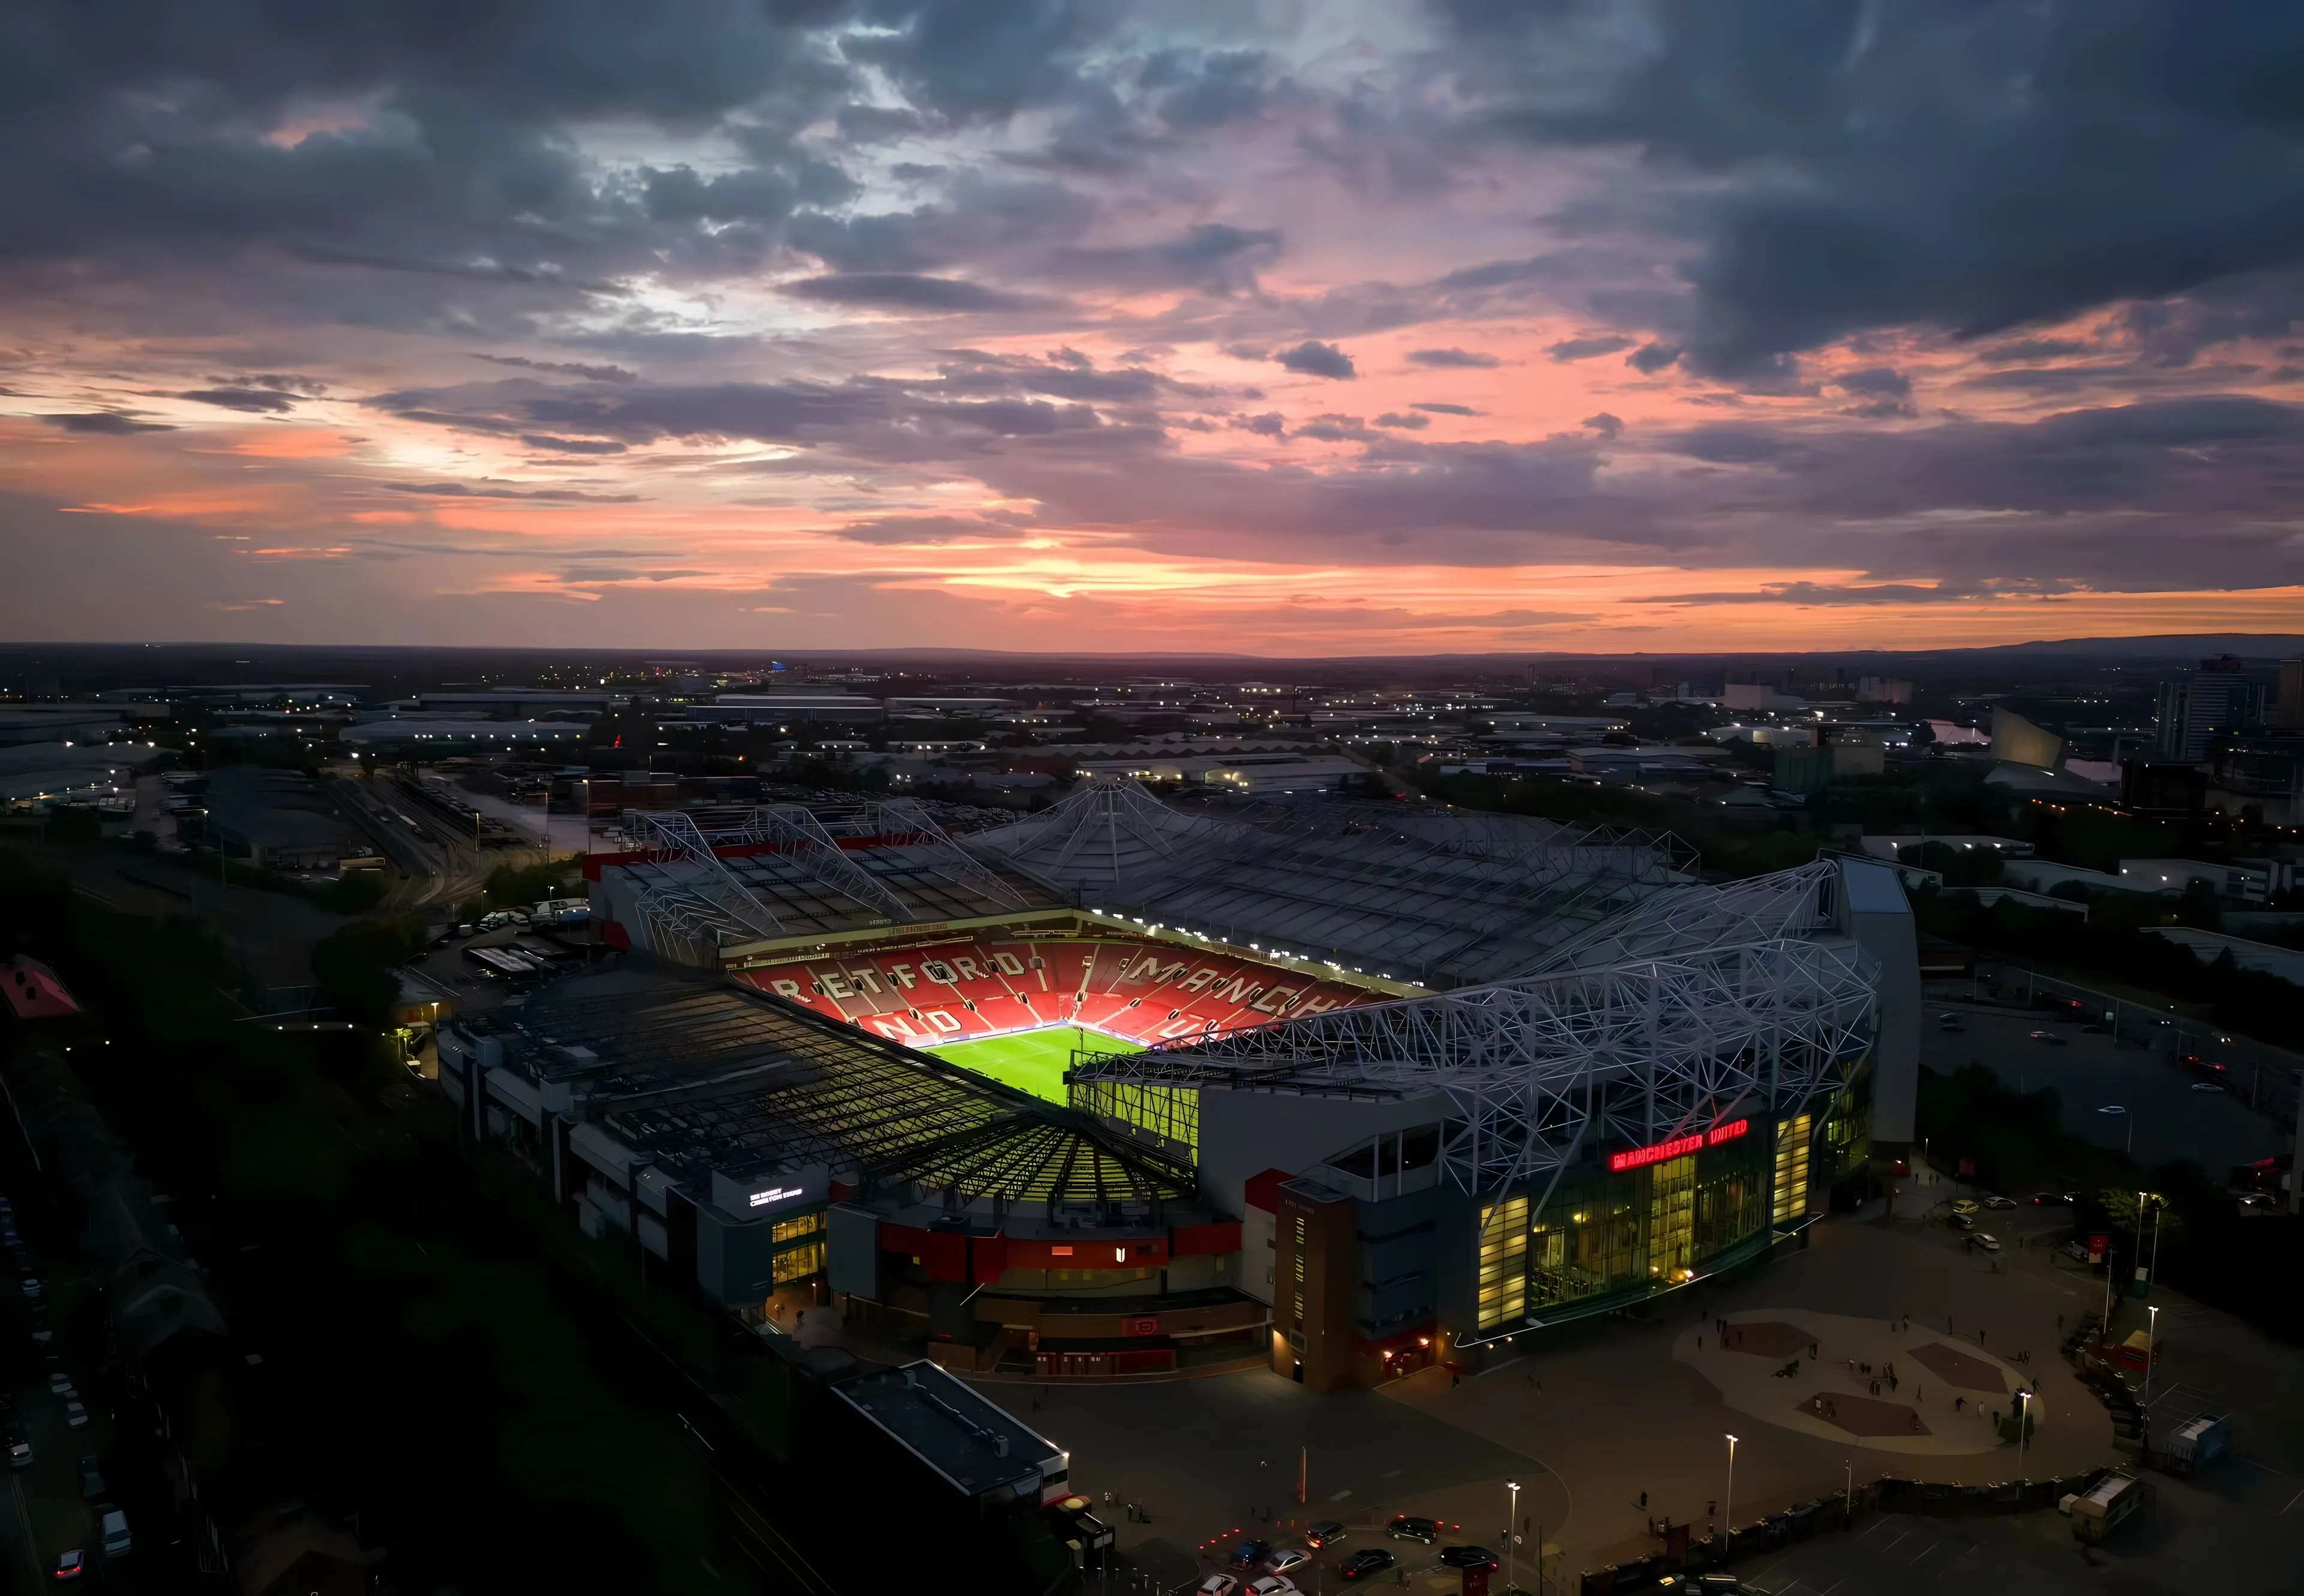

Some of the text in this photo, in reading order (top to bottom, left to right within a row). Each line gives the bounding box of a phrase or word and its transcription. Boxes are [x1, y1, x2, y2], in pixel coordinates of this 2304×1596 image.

[770, 953, 1025, 1003] RETFORD
[1614, 1120, 1747, 1169] MANCHESTER UNITED
